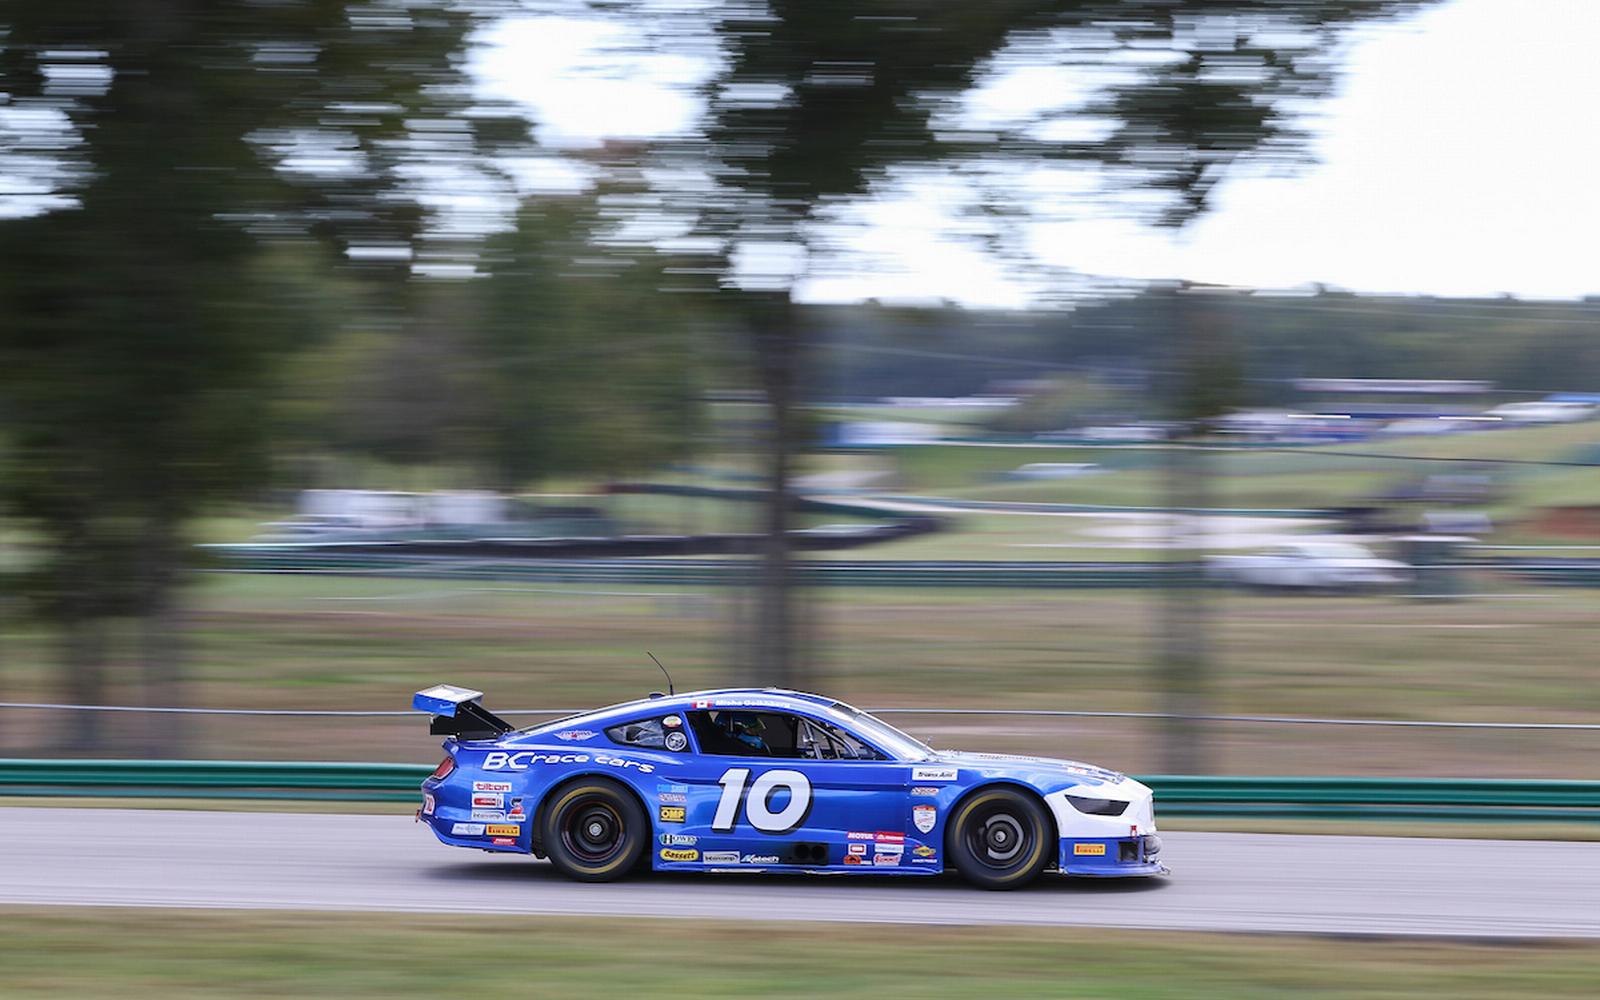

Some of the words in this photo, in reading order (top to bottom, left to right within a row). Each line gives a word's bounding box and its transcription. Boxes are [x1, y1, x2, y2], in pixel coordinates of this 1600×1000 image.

[594, 755, 656, 773] cars
[476, 783, 510, 791] tilton
[711, 767, 813, 835] 10
[661, 809, 685, 819] OMP
[488, 826, 519, 834] PIRELLI
[1075, 845, 1104, 854] PIRELLI
